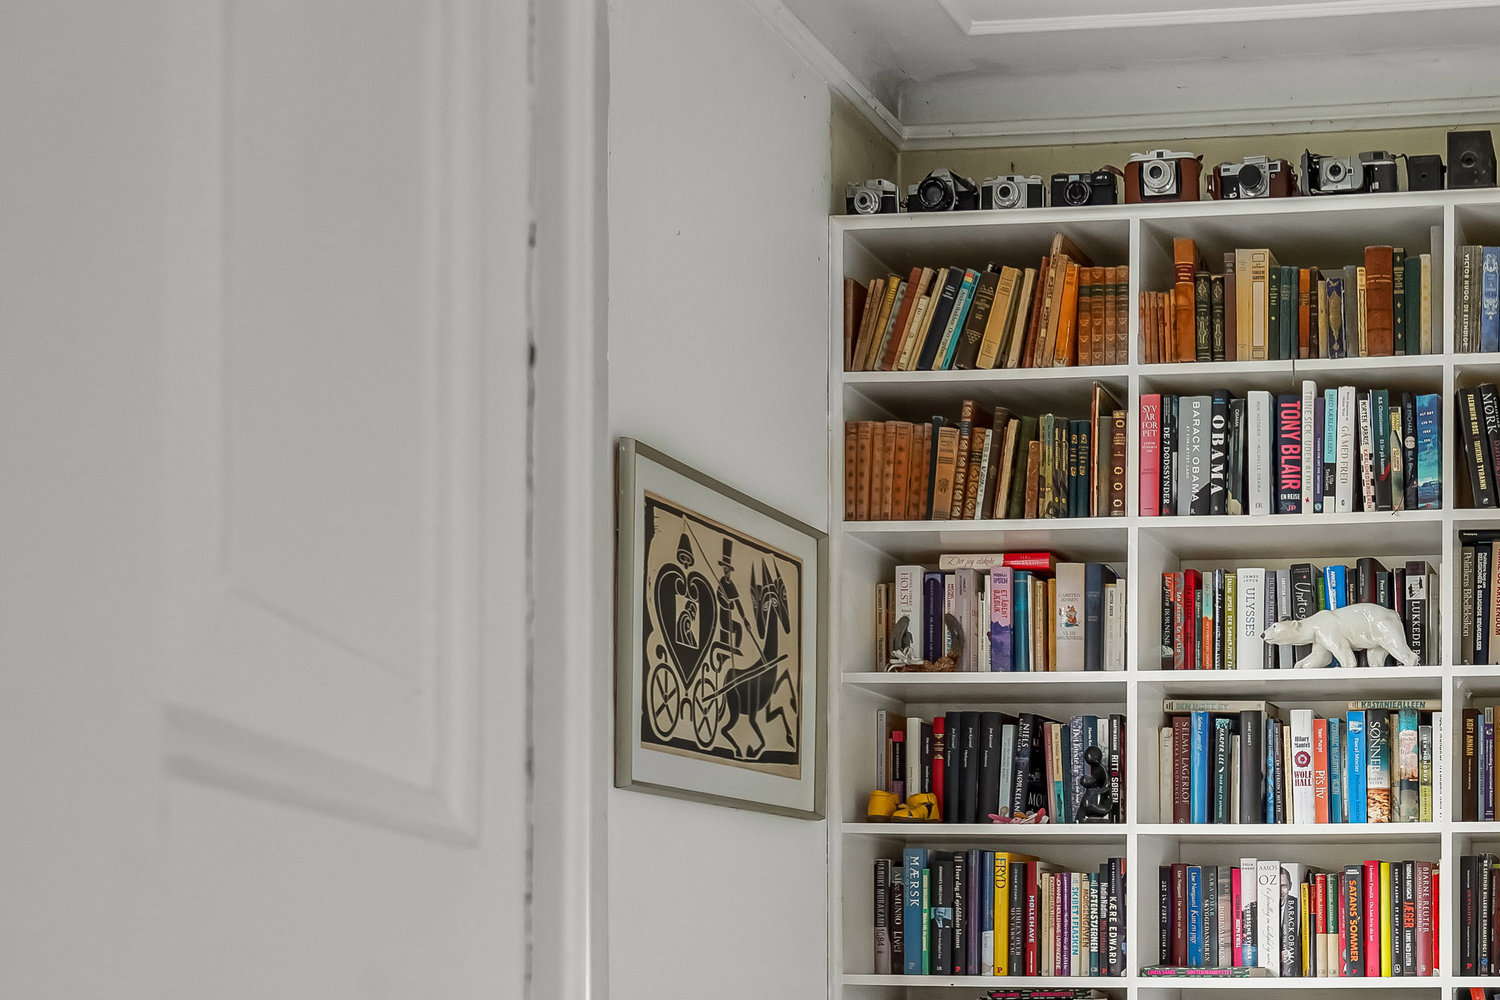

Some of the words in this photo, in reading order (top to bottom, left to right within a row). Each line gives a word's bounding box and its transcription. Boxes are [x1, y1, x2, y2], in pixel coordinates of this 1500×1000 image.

[1192, 402, 1201, 451] BARACK
[1281, 401, 1300, 441] TONY
[1482, 393, 1497, 434] MØRK
[1163, 427, 1170, 436] DE
[1340, 426, 1352, 441] GÅ
[1211, 415, 1225, 494] OBAMA
[1281, 444, 1301, 489] BLAIR
[1340, 443, 1349, 459] MED
[1191, 457, 1200, 502] OBAMA
[1340, 461, 1349, 484] FRED
[1462, 552, 1471, 586] Politikens
[900, 572, 909, 607] HOLST
[1163, 608, 1171, 645] BØRNENE
[1245, 587, 1255, 637] ULYSSES
[1411, 601, 1420, 647] LUKKEDE
[1462, 588, 1472, 637] Bibelleksikon
[1362, 700, 1426, 708] KASTANIEALLEEN
[1021, 723, 1030, 748] NIELS
[1181, 722, 1189, 755] SELMA
[1370, 721, 1381, 772] SØNNER
[1111, 755, 1119, 771] RITT
[1315, 770, 1326, 783] Pi's
[1111, 777, 1119, 803] SØREN
[1315, 784, 1326, 799] liv
[909, 856, 920, 907] MÆRSK
[996, 858, 1006, 888] FRYD
[1259, 875, 1277, 885] OZ
[1422, 867, 1430, 898] BJARNE
[1109, 896, 1117, 922] KÆRE
[1349, 880, 1358, 916] SATANS
[1089, 888, 1099, 952] AFTENSTJERNEN
[1422, 900, 1430, 932] REUTER
[1109, 926, 1117, 964] EDWARD
[1350, 919, 1359, 962] SOMMER
